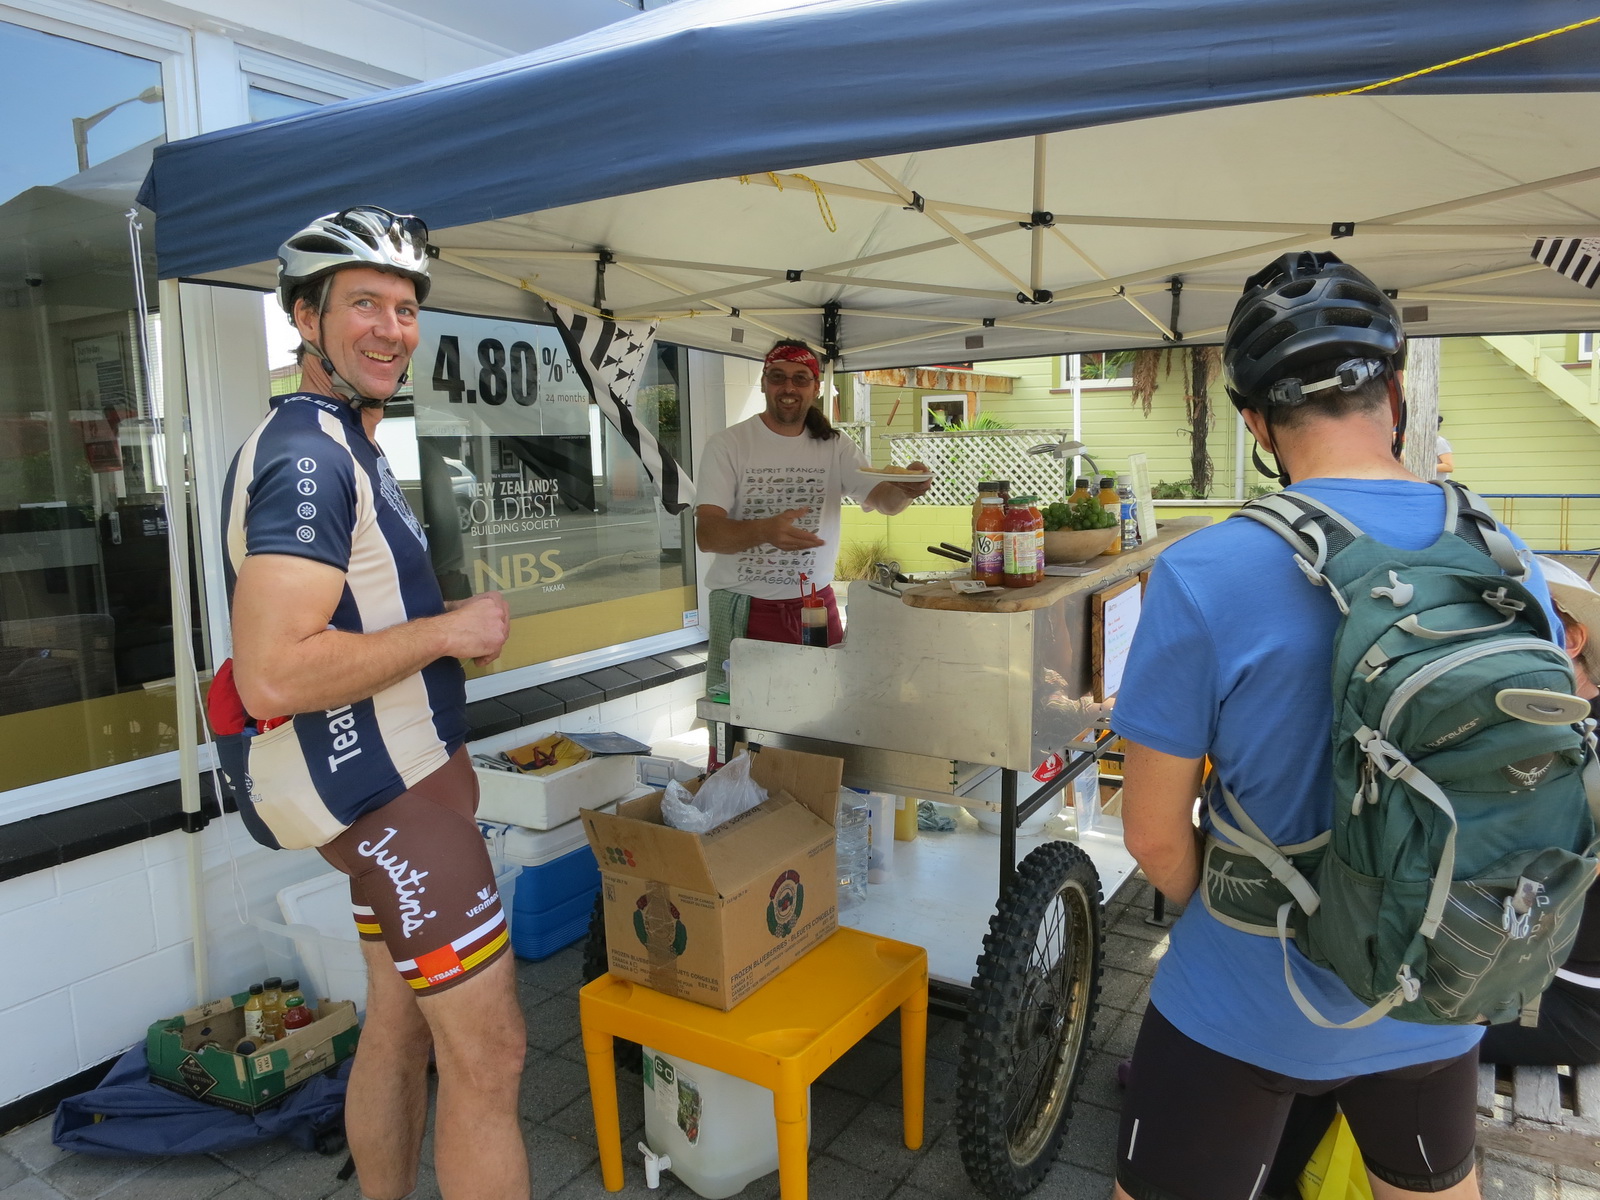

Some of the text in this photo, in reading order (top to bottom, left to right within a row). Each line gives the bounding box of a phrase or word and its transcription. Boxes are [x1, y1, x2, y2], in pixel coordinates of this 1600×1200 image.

[546, 392, 586, 403] 24 months
[468, 479, 558, 497] NEW ZEALAND'S
[470, 493, 559, 524] OLDEST
[471, 518, 560, 537] BUILDING SOCIETY
[473, 549, 564, 594] NBS
[542, 583, 566, 593] TAKAKA
[358, 828, 437, 938] Justin's
[730, 965, 753, 983] FROZEN
[753, 940, 788, 968] BLUEBERRIES
